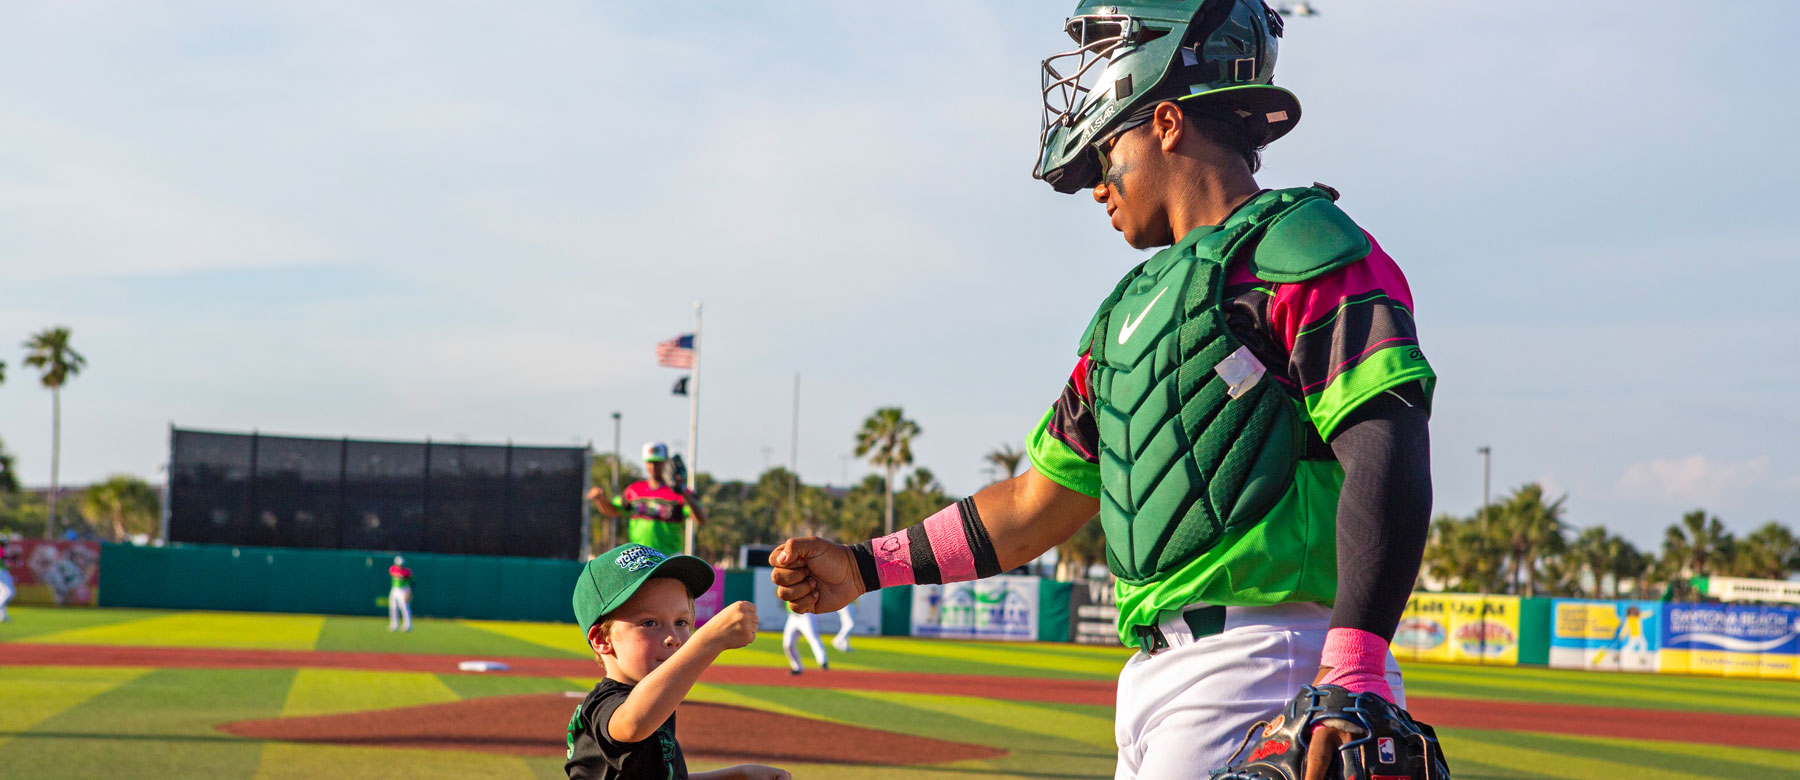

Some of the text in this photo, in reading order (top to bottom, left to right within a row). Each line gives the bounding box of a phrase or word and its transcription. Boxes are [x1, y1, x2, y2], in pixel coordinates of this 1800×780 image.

[1083, 105, 1115, 139] ALL-STAR
[1671, 608, 1788, 627] DAYTONA BEACH
